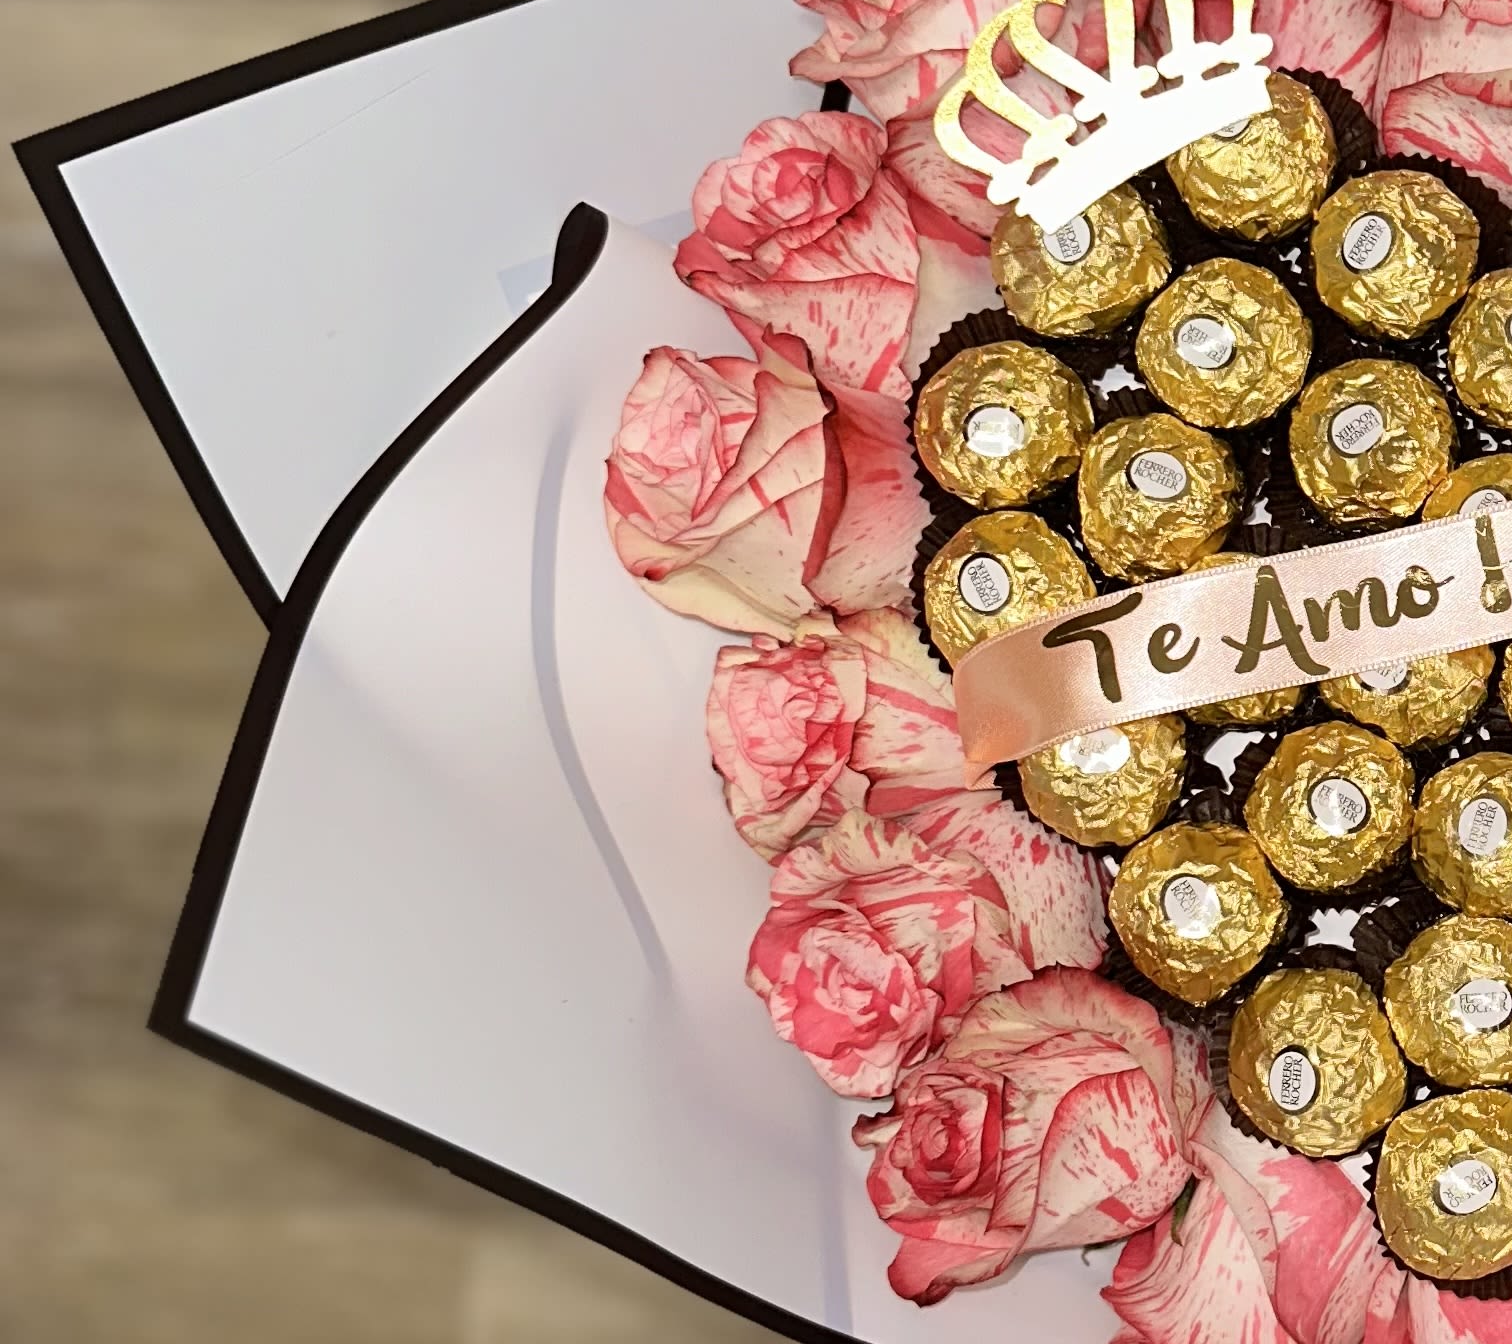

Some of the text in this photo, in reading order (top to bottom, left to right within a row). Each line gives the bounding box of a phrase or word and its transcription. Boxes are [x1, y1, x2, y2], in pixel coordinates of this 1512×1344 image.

[1348, 218, 1378, 262] FERRERO
[1355, 225, 1384, 265] ROCHER
[1335, 409, 1375, 441] ROCHER
[1341, 418, 1380, 450] FERRERO
[1133, 467, 1179, 493] ROCHER
[1138, 458, 1183, 483] FERRERO
[967, 566, 994, 608] FERRERO
[976, 560, 1002, 605] ROCHER
[1042, 592, 1200, 704] Te
[1221, 563, 1454, 676] Amo
[1317, 784, 1364, 814] FERERO
[1280, 1055, 1294, 1105] FERRERO
[1289, 1057, 1304, 1106] ROCHER
